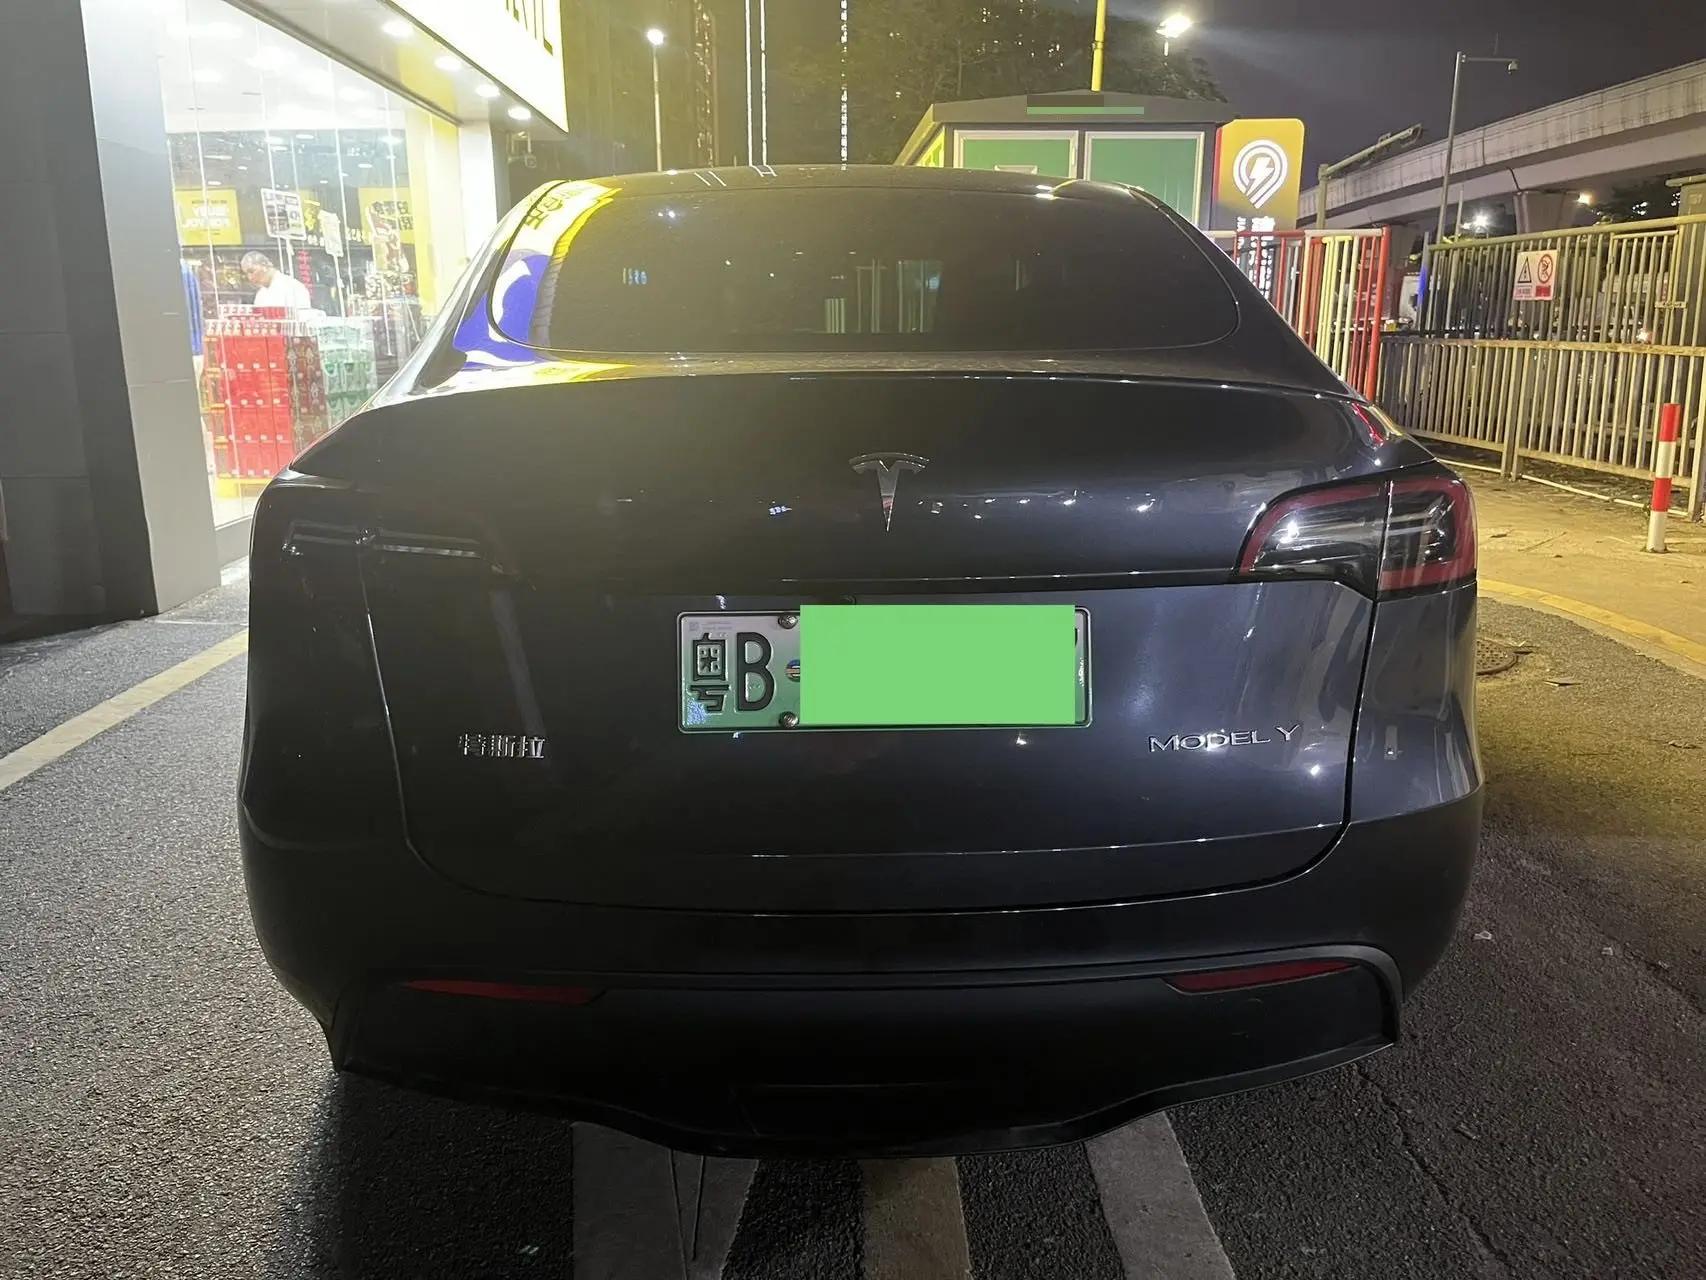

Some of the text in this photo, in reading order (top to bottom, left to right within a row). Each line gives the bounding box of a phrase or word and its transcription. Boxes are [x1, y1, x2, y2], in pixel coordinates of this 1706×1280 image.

[457, 733, 546, 758] 特斯拉
[1149, 724, 1300, 752] MODEL Y
